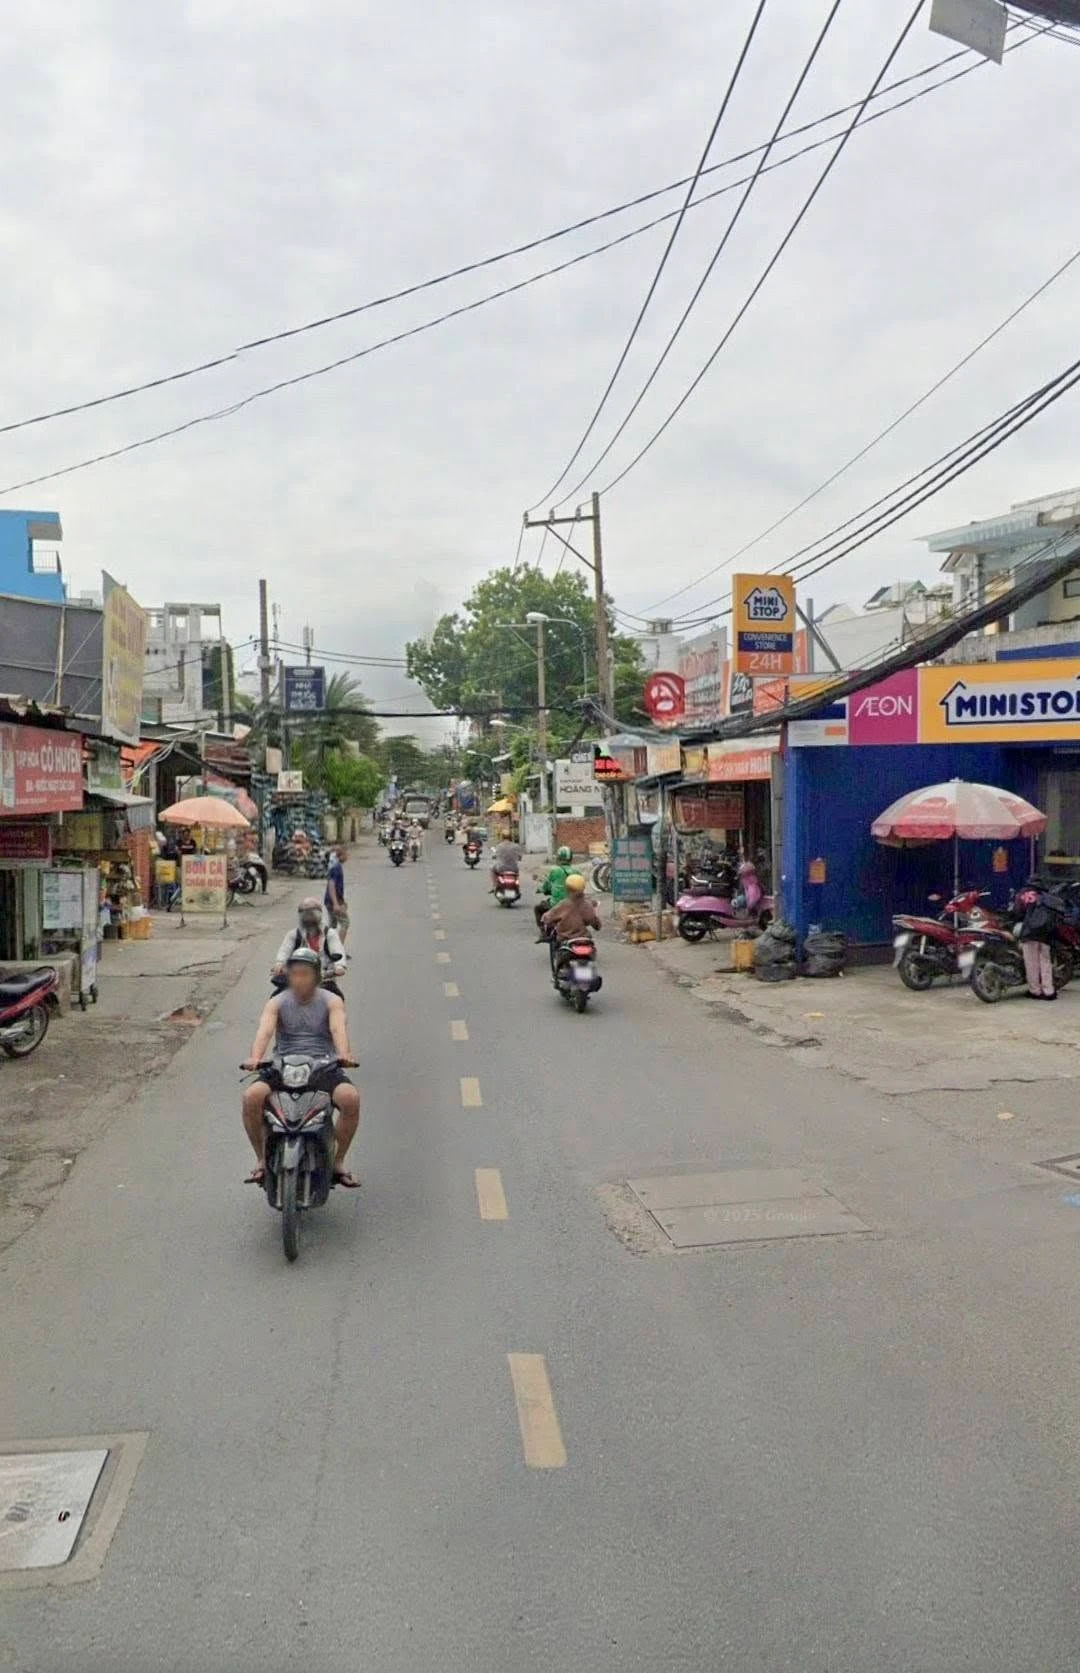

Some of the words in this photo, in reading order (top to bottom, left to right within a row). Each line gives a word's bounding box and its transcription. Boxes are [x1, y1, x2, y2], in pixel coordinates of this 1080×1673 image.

[753, 596, 778, 605] MINI
[753, 607, 779, 616] STOP
[743, 633, 788, 641] CONVENIENCE
[754, 641, 777, 650] STORE
[749, 654, 783, 670] 24H
